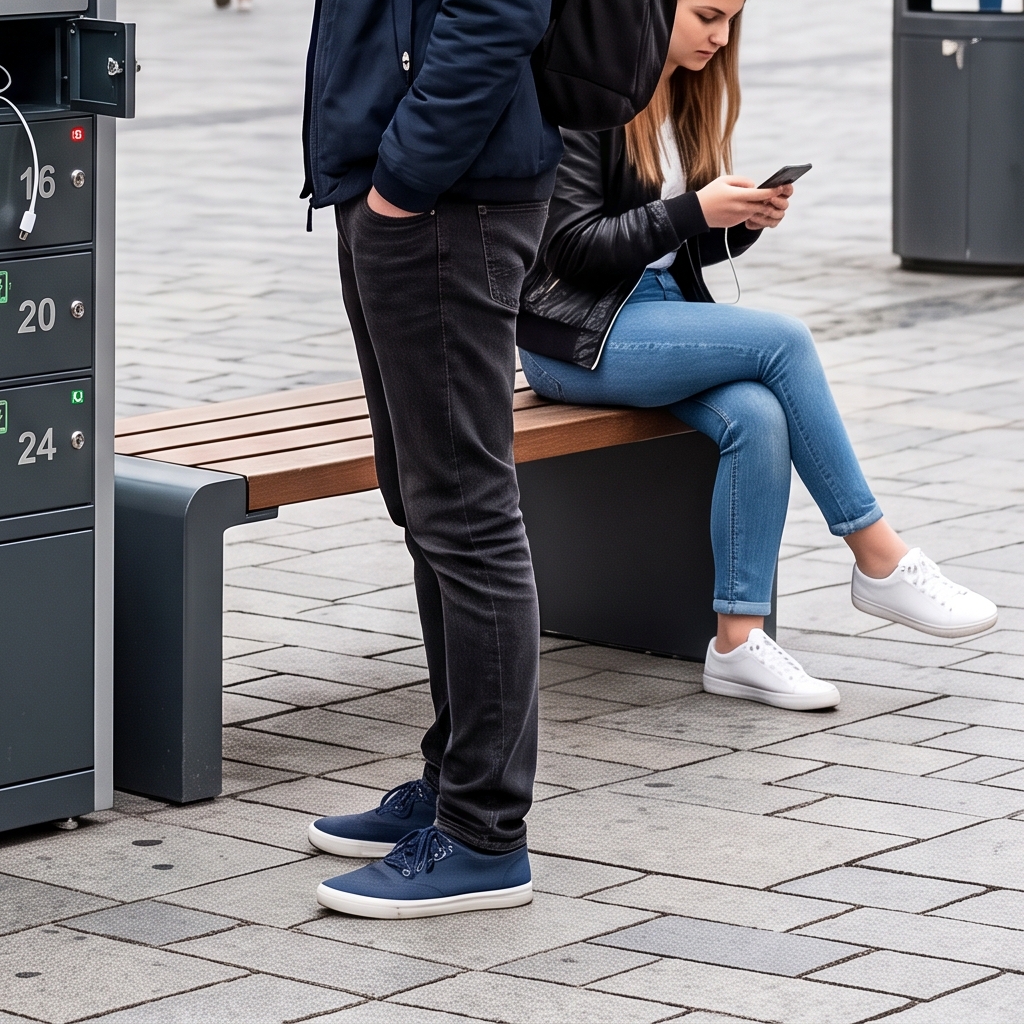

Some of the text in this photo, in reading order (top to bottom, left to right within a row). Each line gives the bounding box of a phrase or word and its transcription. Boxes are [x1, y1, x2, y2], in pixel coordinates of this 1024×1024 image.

[20, 164, 56, 200] 16
[17, 297, 56, 334] 20
[17, 427, 57, 466] 24
